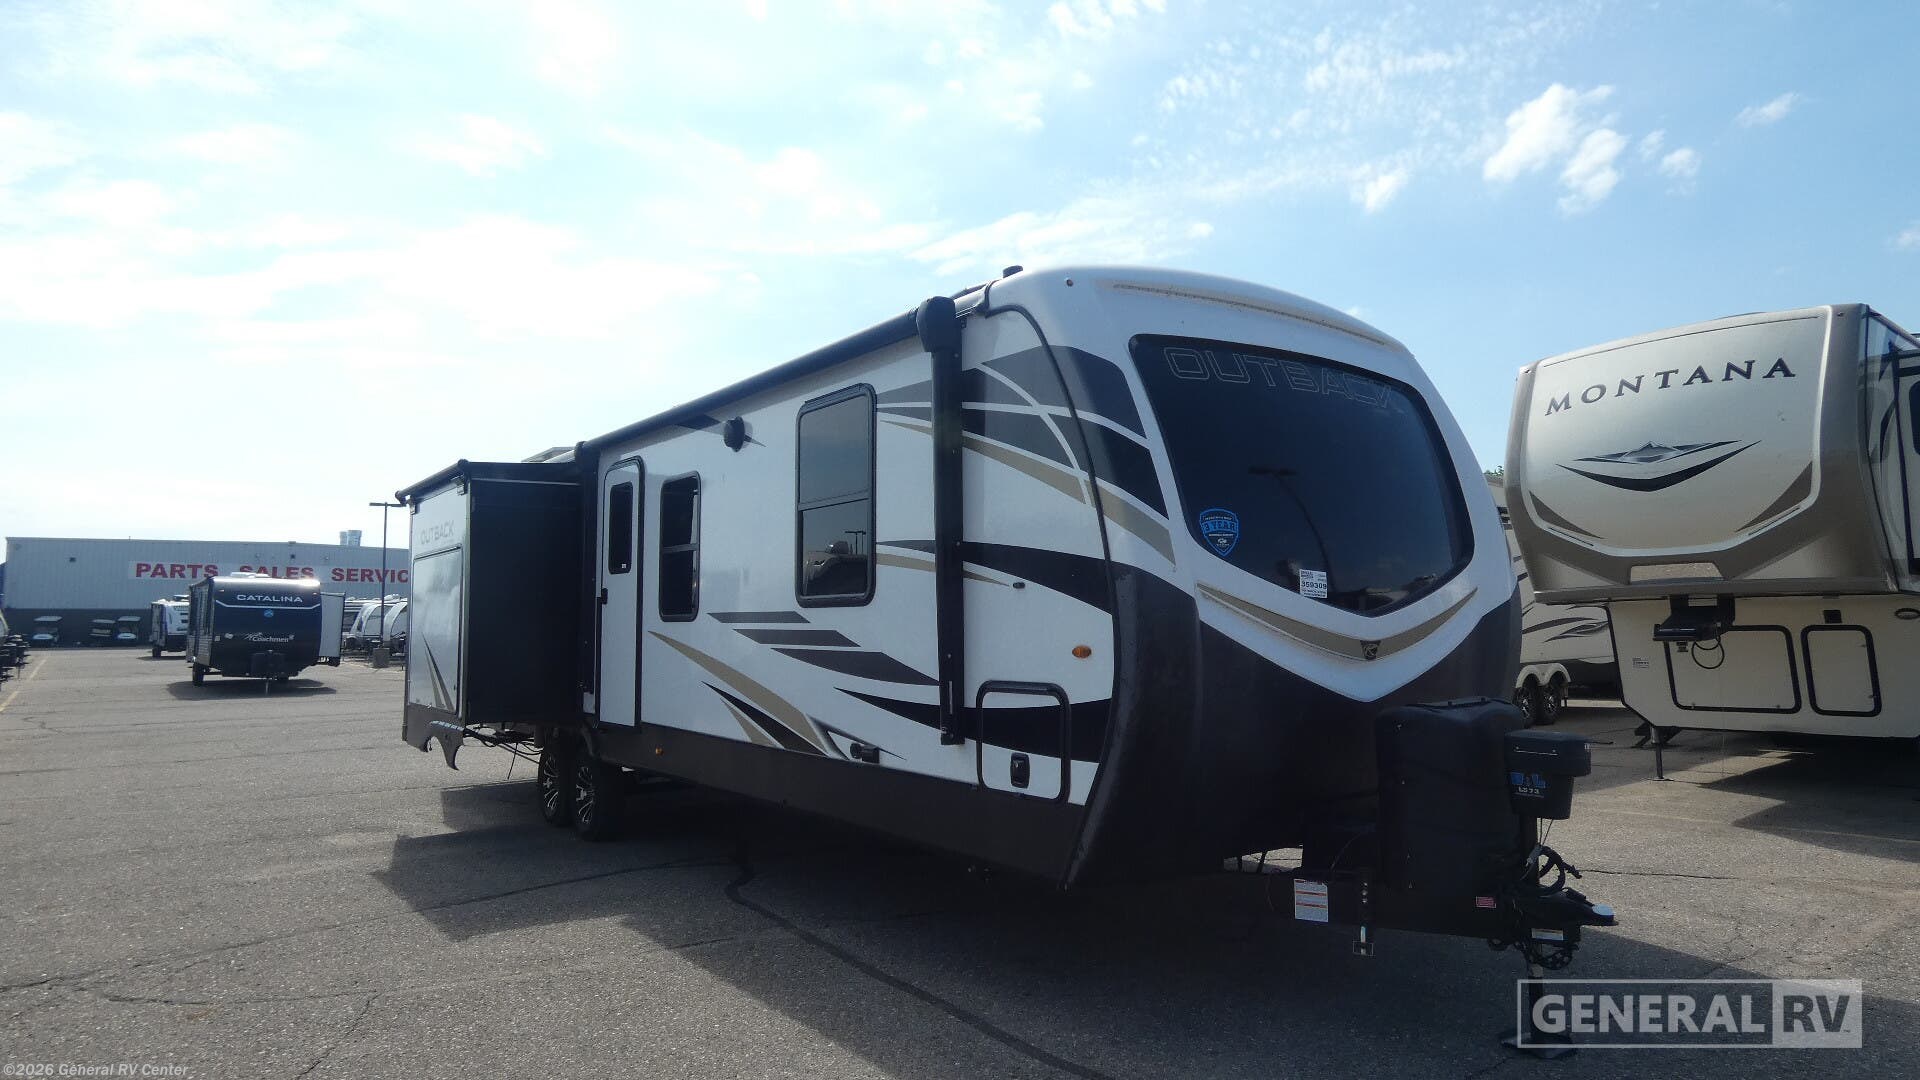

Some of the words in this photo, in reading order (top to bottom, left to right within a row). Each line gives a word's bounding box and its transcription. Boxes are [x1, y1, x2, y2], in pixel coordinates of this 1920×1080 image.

[1544, 358, 1796, 416] MONTANA
[420, 520, 455, 545] OUTBACK
[135, 563, 219, 579] PARTS
[236, 594, 303, 603] CATALINA
